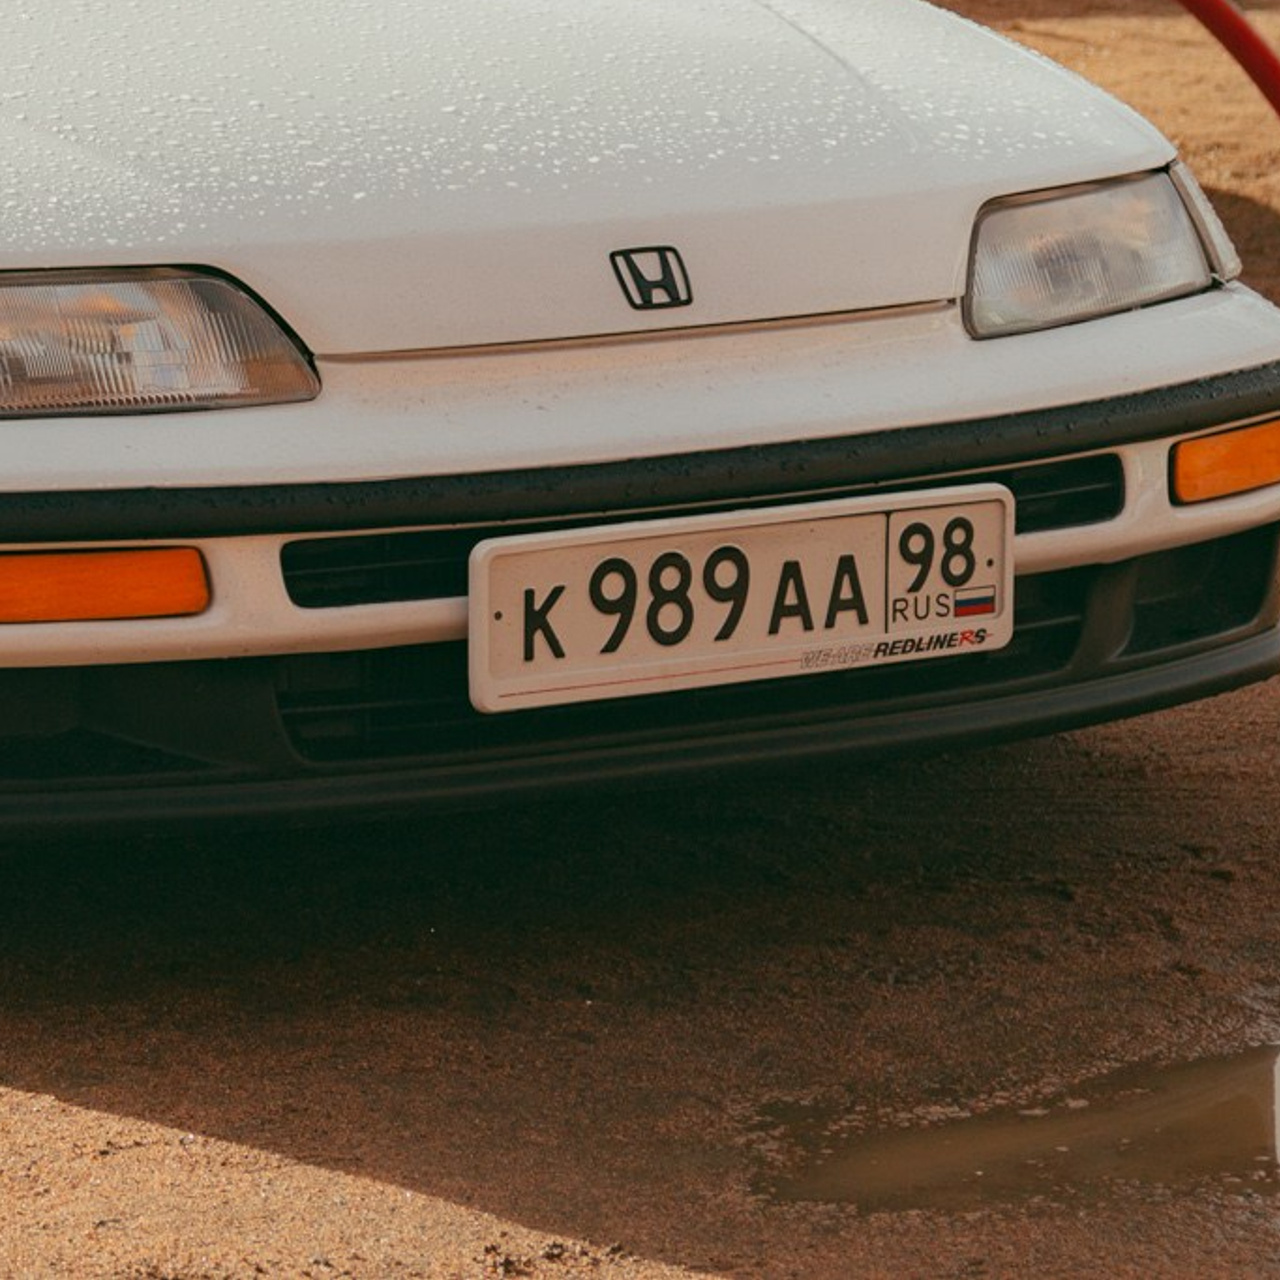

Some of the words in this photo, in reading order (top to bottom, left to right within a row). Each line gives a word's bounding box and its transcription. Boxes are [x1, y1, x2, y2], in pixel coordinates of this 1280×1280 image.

[899, 516, 976, 594] 98
[892, 593, 951, 623] RUS
[874, 628, 988, 659] REDLINERS
